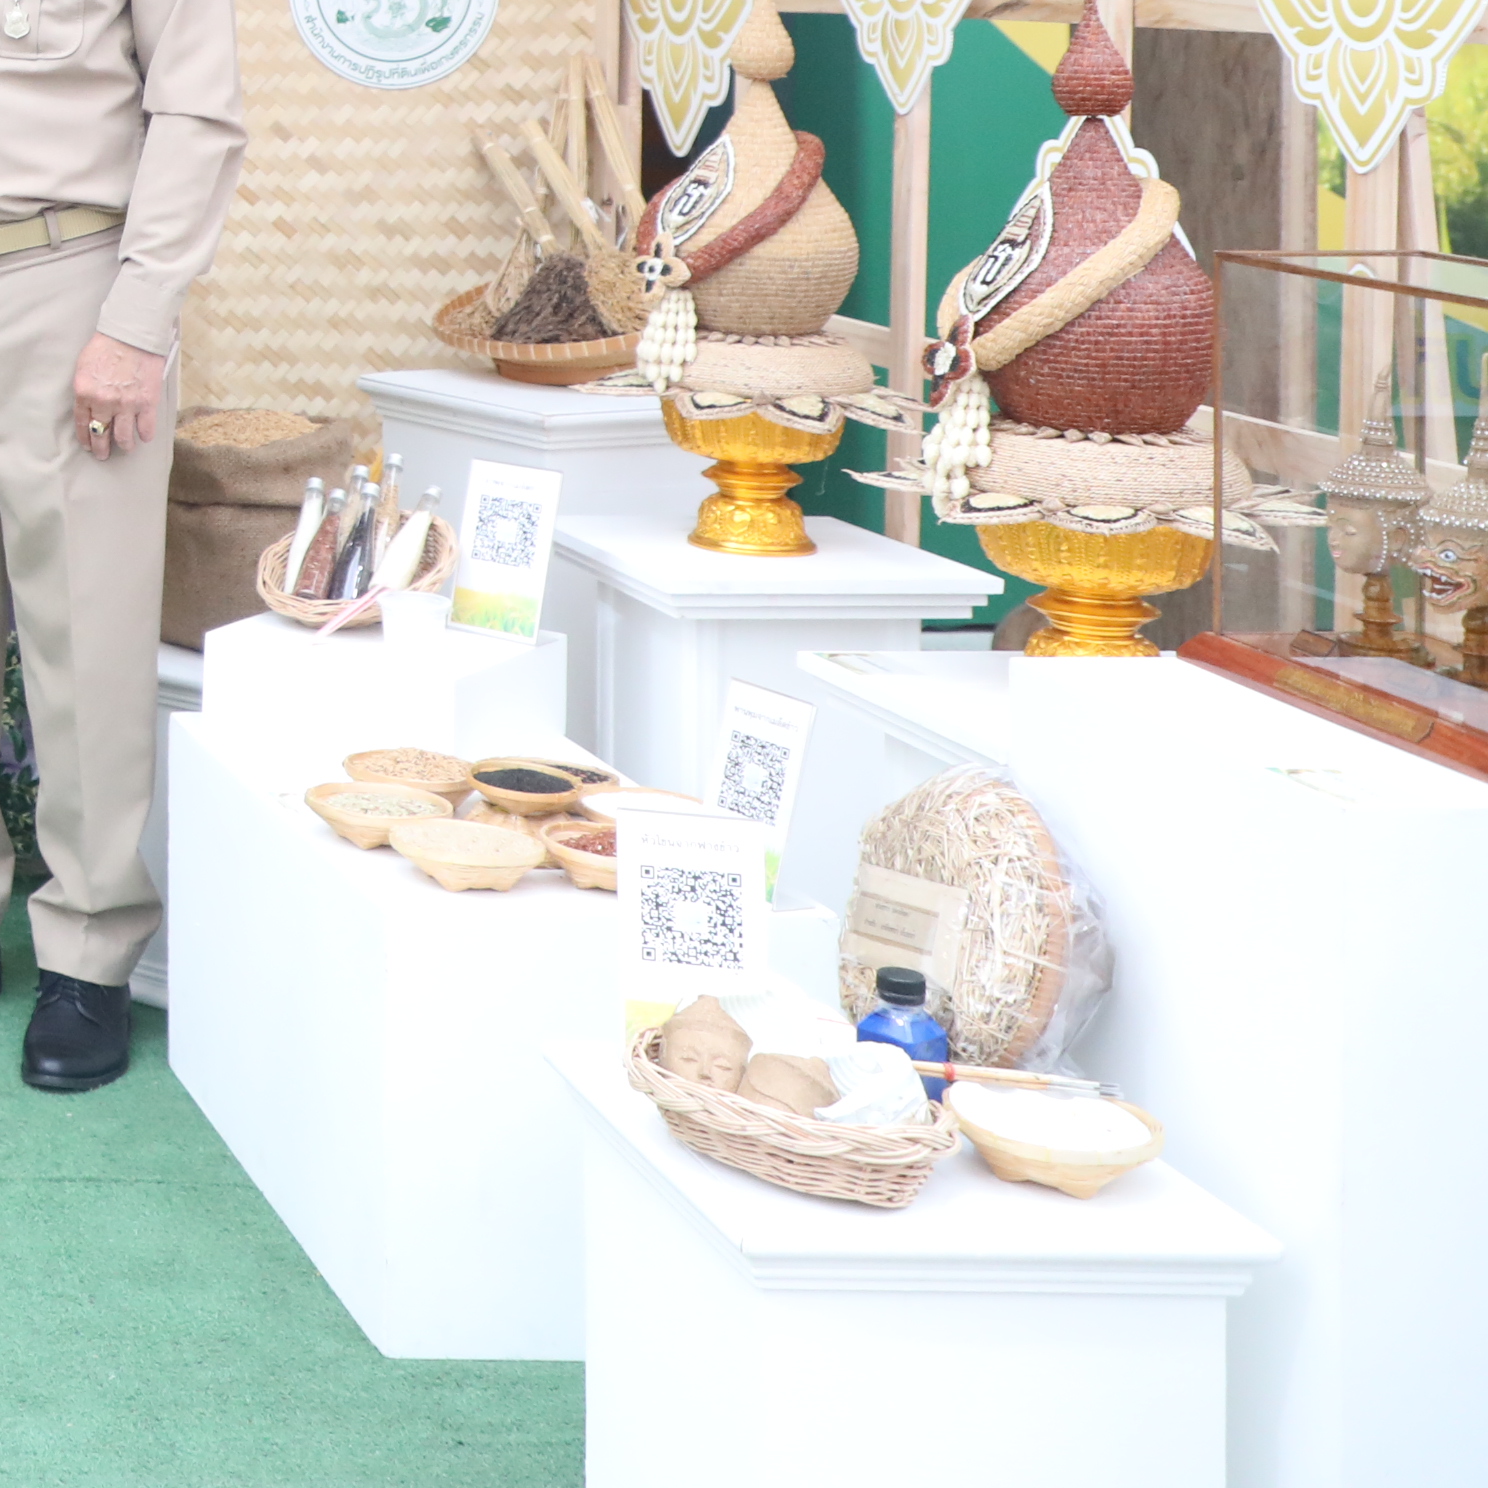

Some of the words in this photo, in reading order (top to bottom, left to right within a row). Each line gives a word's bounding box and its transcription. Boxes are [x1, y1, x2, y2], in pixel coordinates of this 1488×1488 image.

[304, 11, 485, 83] สำนักงานการปฏิรูปที่ดินเพื่อเกษตรกรรม
[640, 833, 740, 854] หัวโขนจากฟางข้าว
